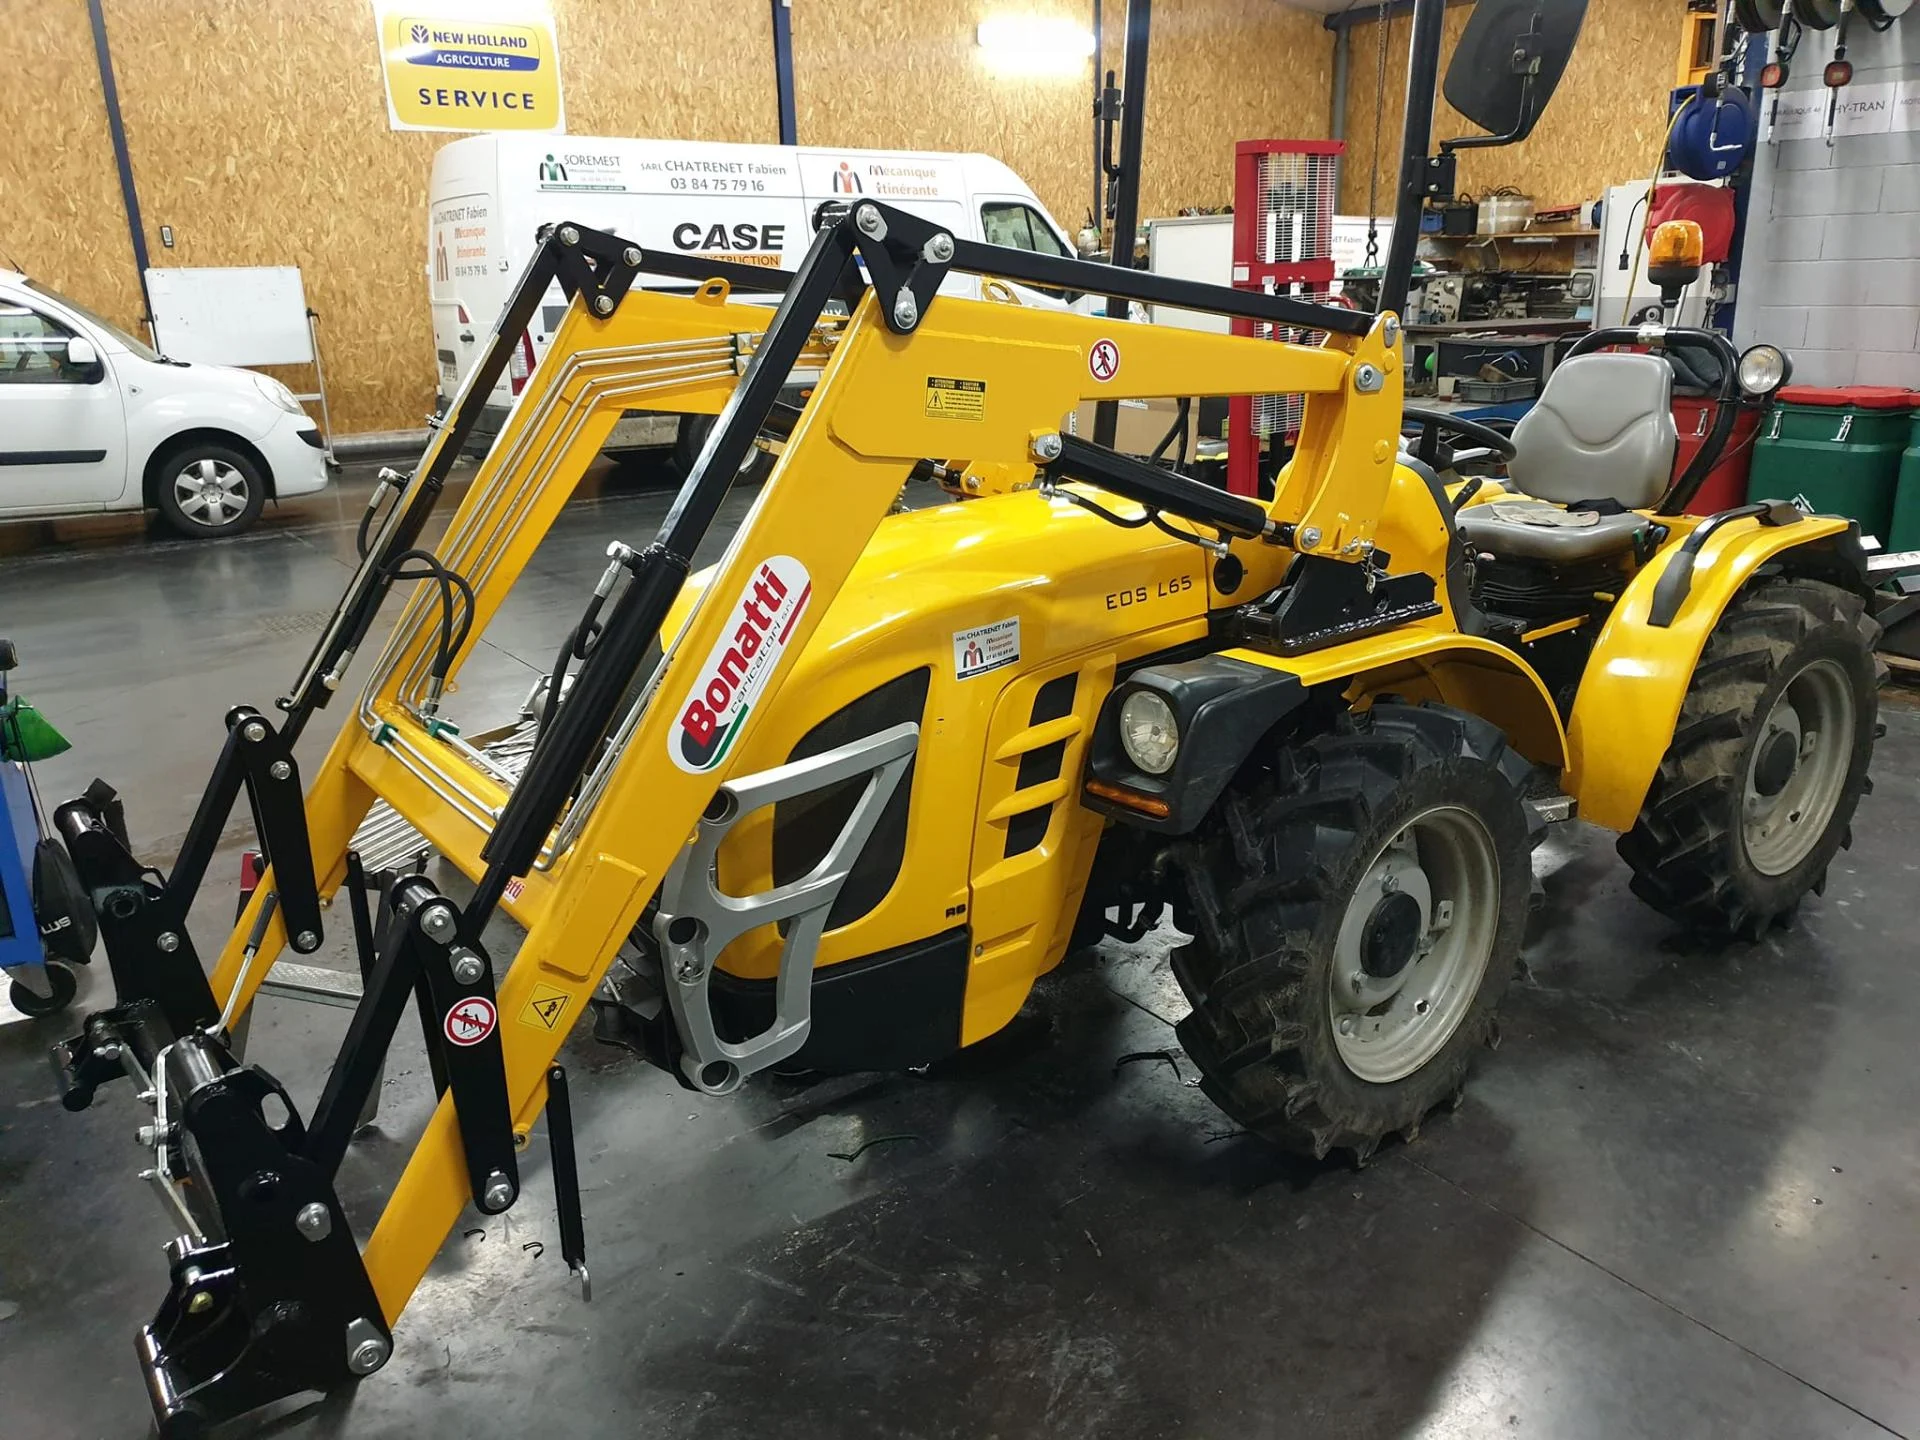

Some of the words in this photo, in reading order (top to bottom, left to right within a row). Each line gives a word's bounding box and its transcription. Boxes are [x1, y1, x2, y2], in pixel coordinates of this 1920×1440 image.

[433, 31, 463, 44] NEW
[468, 34, 527, 48] HOLLAND
[436, 54, 510, 68] AGRICULTURE
[419, 88, 535, 110] SERVICE
[1835, 101, 1885, 114] HY-TRAN
[564, 154, 620, 167] SOREMEST
[640, 160, 663, 171] SARL
[664, 160, 743, 173] CHATRENET
[748, 163, 786, 175] Fabien
[670, 177, 686, 190] 03
[692, 178, 708, 190] 84
[712, 179, 727, 190] 75
[732, 180, 747, 191] 79
[752, 180, 765, 191] 16
[672, 222, 785, 250] CASE
[1106, 587, 1148, 610] EOS
[1158, 575, 1192, 597] L65
[967, 625, 1001, 639] CHATRENET
[681, 563, 788, 748] Bonatti
[730, 619, 781, 714] caricatori
